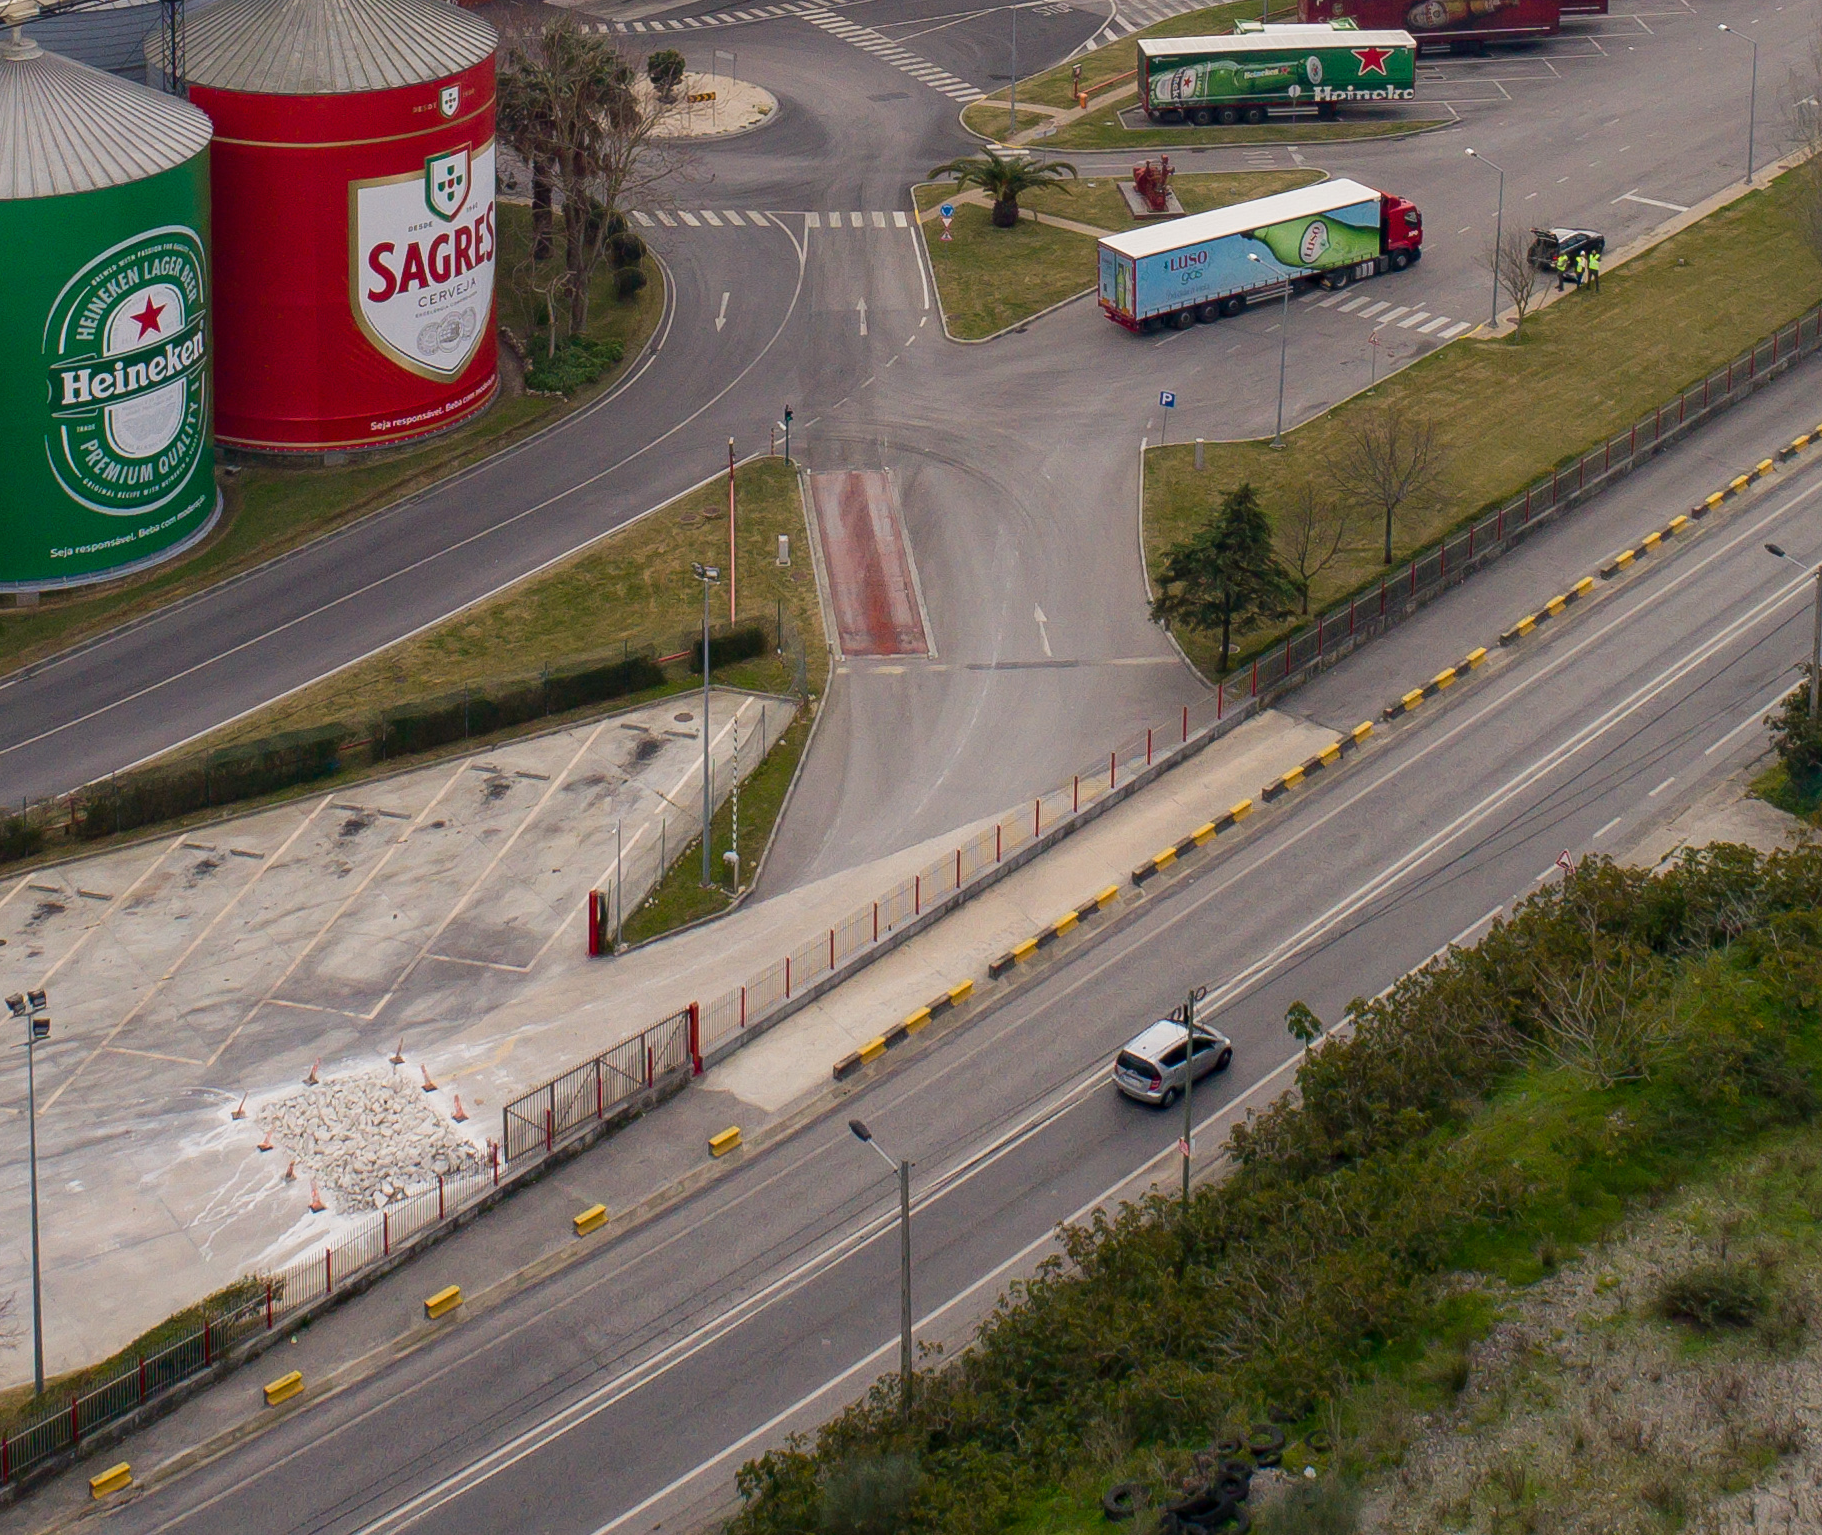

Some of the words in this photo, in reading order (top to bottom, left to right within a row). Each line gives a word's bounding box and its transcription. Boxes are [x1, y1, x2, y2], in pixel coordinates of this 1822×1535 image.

[407, 220, 433, 233] DESDE
[1303, 225, 1322, 258] LUSO
[367, 200, 495, 303] SAGRES
[1170, 249, 1208, 272] LUSO
[75, 266, 140, 341] HEINEKEN
[144, 256, 184, 280] LAGER
[180, 263, 198, 306] BEER
[417, 277, 477, 308] CERVEJA
[60, 330, 205, 406] Heineken
[1161, 392, 1173, 405] P
[370, 418, 392, 431] Seja
[80, 438, 154, 485] PREMIUM
[158, 401, 199, 475] QUALITY
[50, 546, 74, 559] Seja
